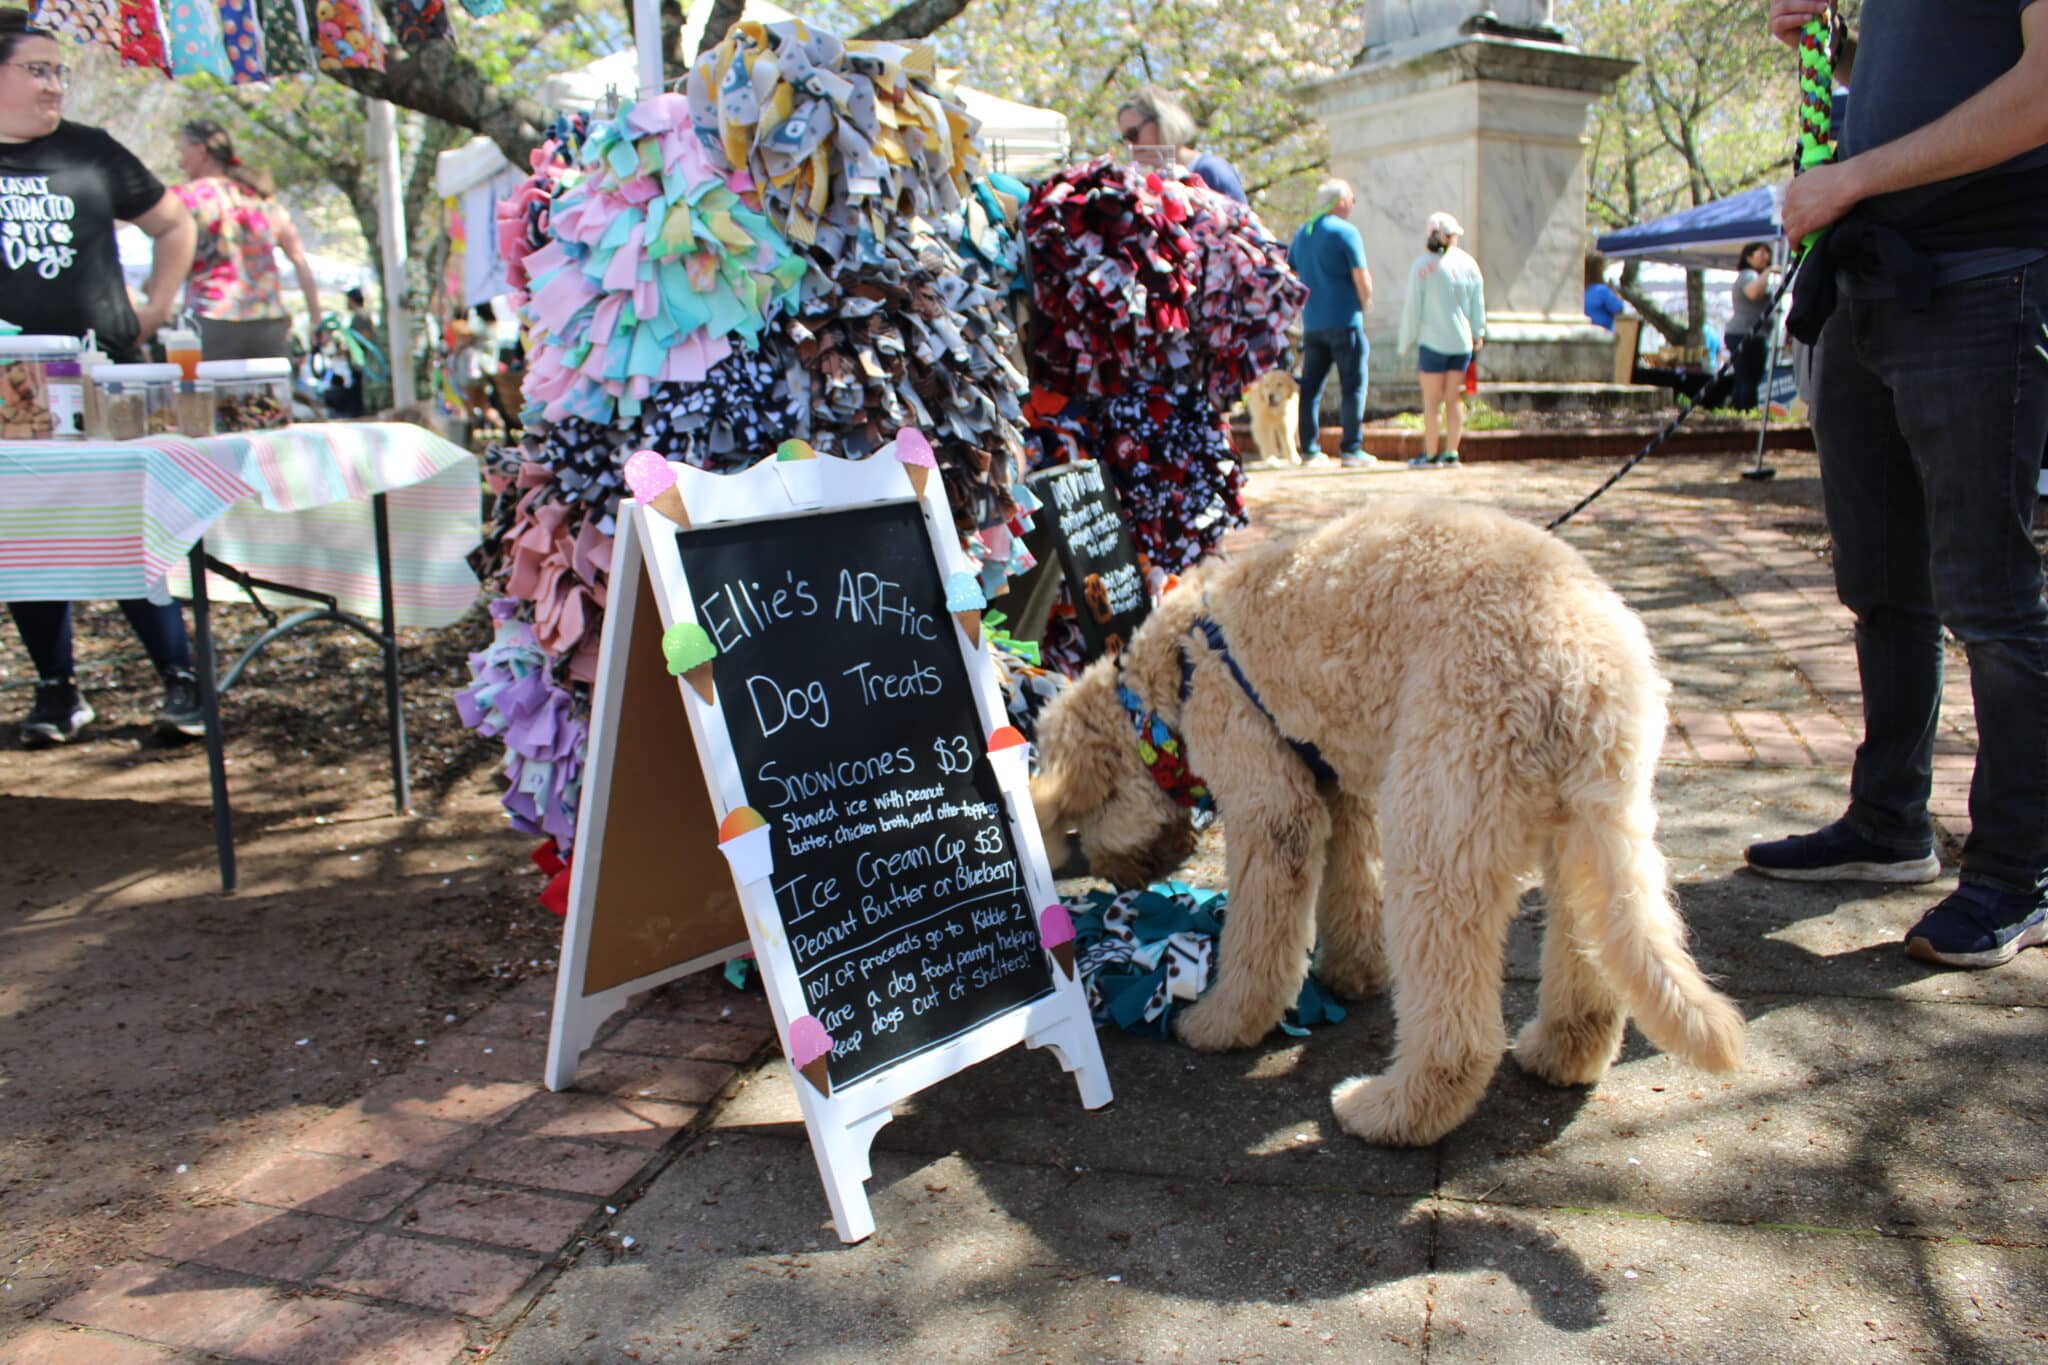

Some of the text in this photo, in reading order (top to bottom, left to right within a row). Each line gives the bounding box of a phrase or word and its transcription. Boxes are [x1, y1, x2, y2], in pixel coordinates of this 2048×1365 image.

[1, 234, 78, 280] Dogs
[22, 220, 50, 246] BY
[701, 570, 818, 653] Ellie's
[746, 660, 943, 738] Dog Treats
[758, 735, 973, 808] Snowcones $3
[782, 800, 838, 833] Shaved
[844, 799, 867, 816] ice
[905, 781, 944, 807] peanut
[775, 826, 1003, 925] Ice Cream Cup $3
[787, 834, 832, 856] butter,
[834, 822, 877, 844] chicken
[792, 859, 1018, 962] Peanut Butter or Blueberry
[807, 972, 835, 1005] 10%
[860, 931, 921, 980] proceeds
[925, 929, 944, 951] go
[944, 920, 964, 938] to
[1011, 903, 1026, 920] 2
[816, 928, 1037, 1033] Care a dog food pantry helping
[872, 1006, 904, 1035] dogs
